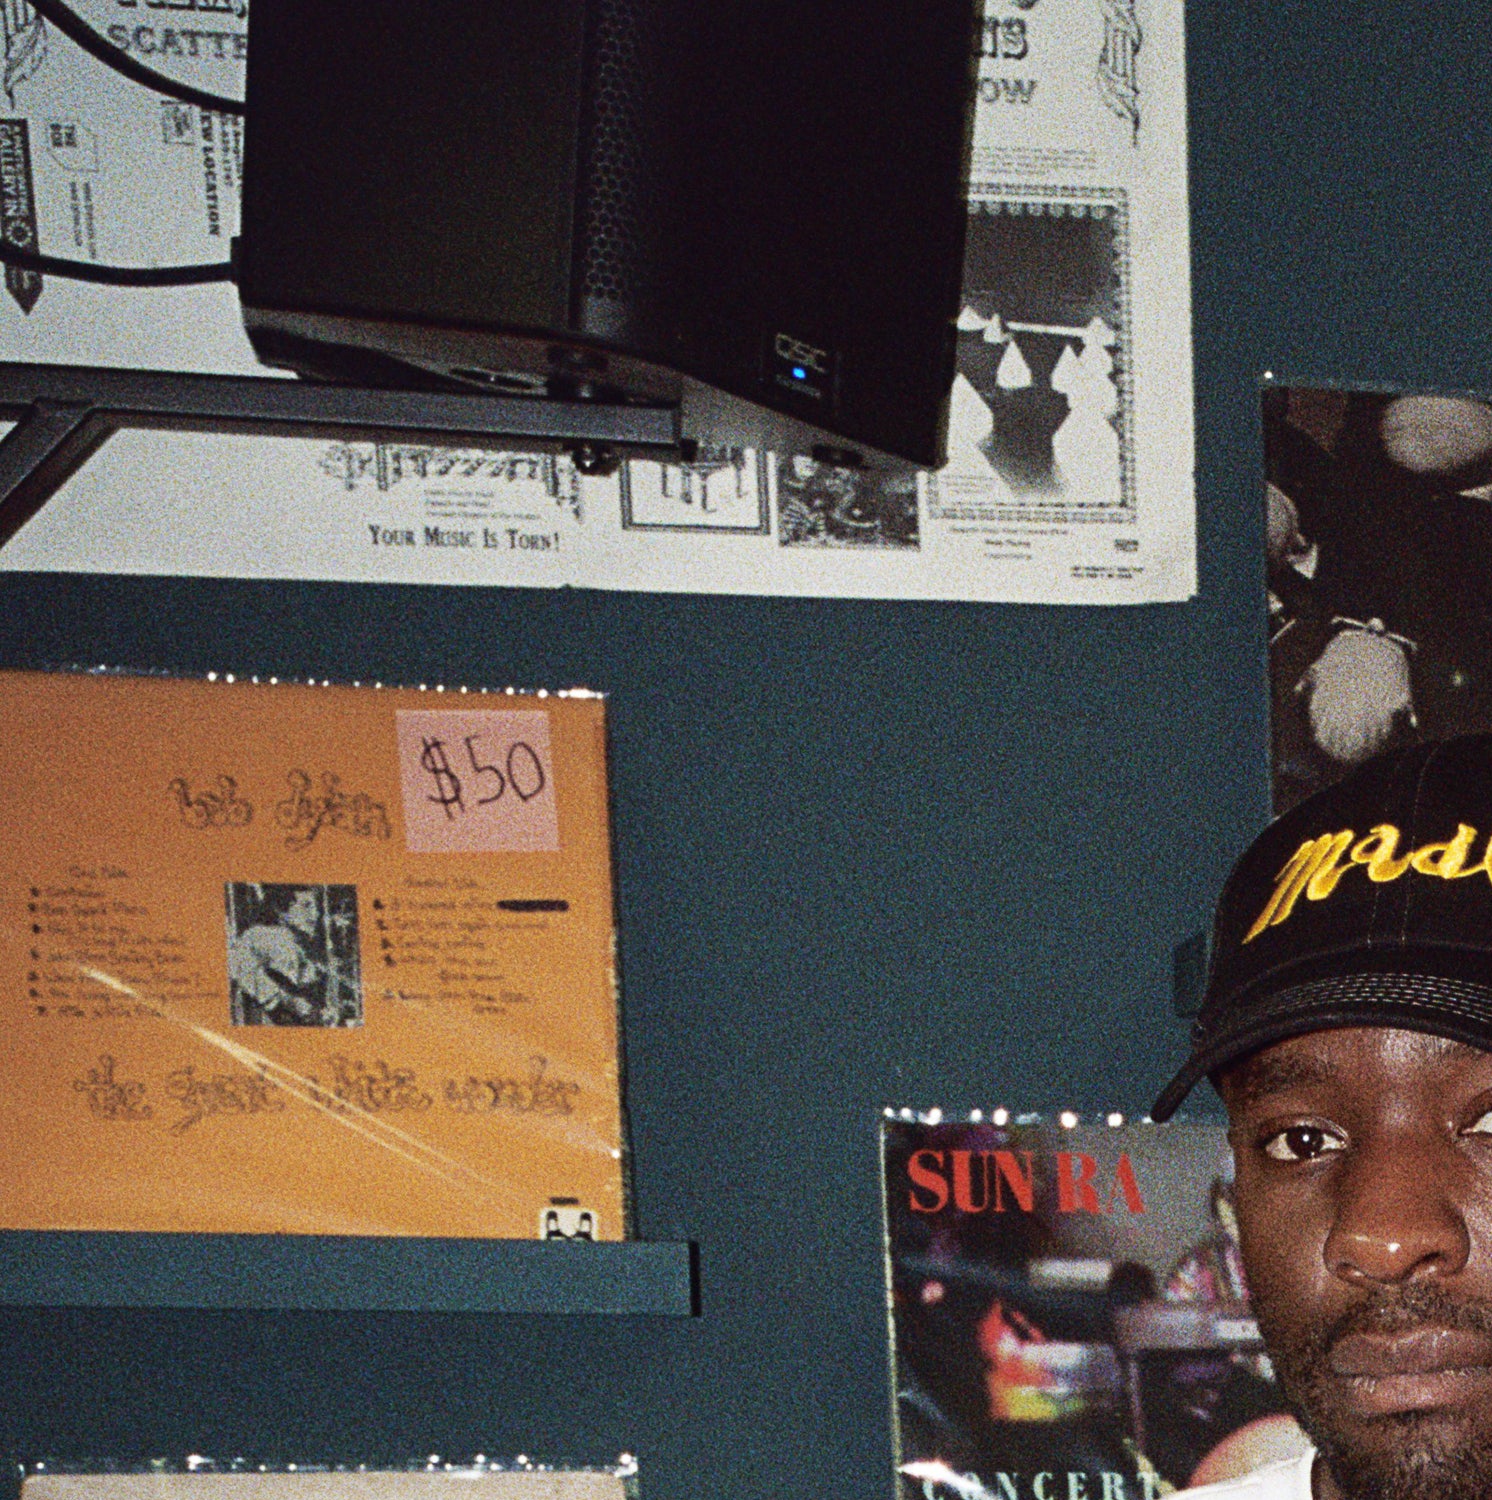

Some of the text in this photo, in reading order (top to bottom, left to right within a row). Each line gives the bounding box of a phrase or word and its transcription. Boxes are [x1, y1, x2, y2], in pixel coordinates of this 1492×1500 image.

[202, 146, 221, 236] LOCATION
[419, 735, 546, 820] $50
[908, 1149, 1147, 1214] SUN RA
